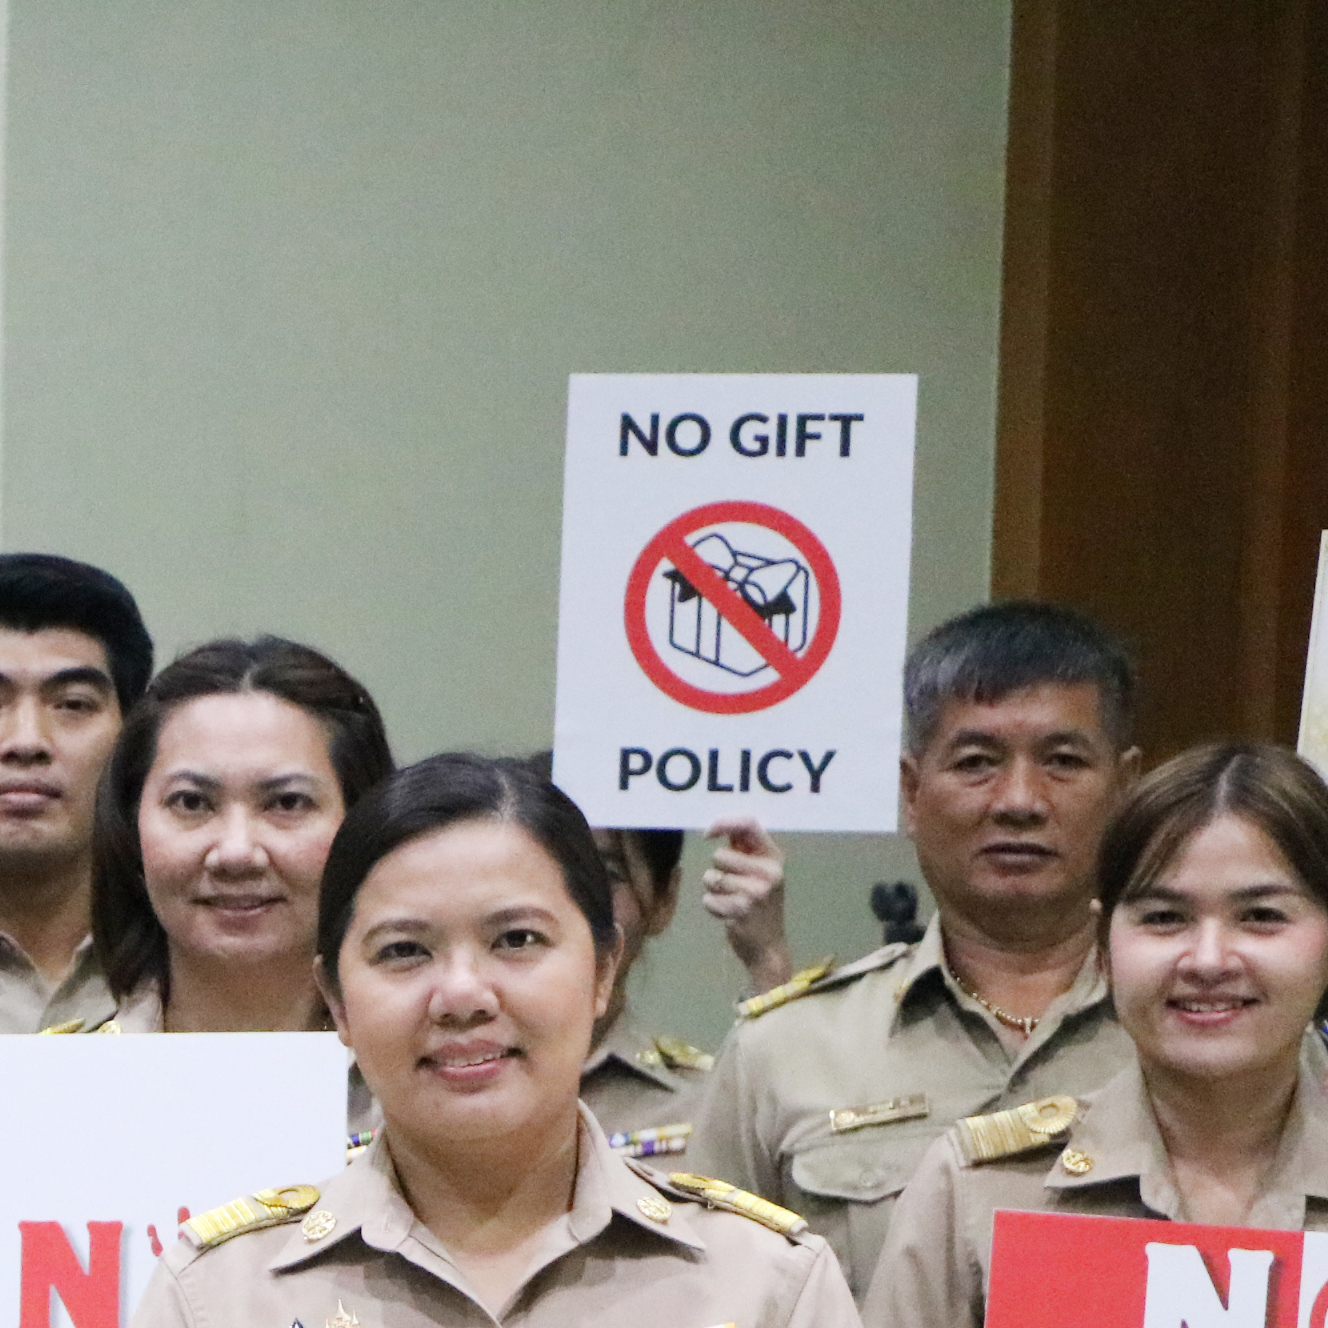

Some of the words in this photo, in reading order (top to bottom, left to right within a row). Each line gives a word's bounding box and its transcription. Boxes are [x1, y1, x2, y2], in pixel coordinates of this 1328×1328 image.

[619, 412, 711, 457] NO
[729, 412, 864, 457] GIFT
[618, 747, 837, 794] POLICY
